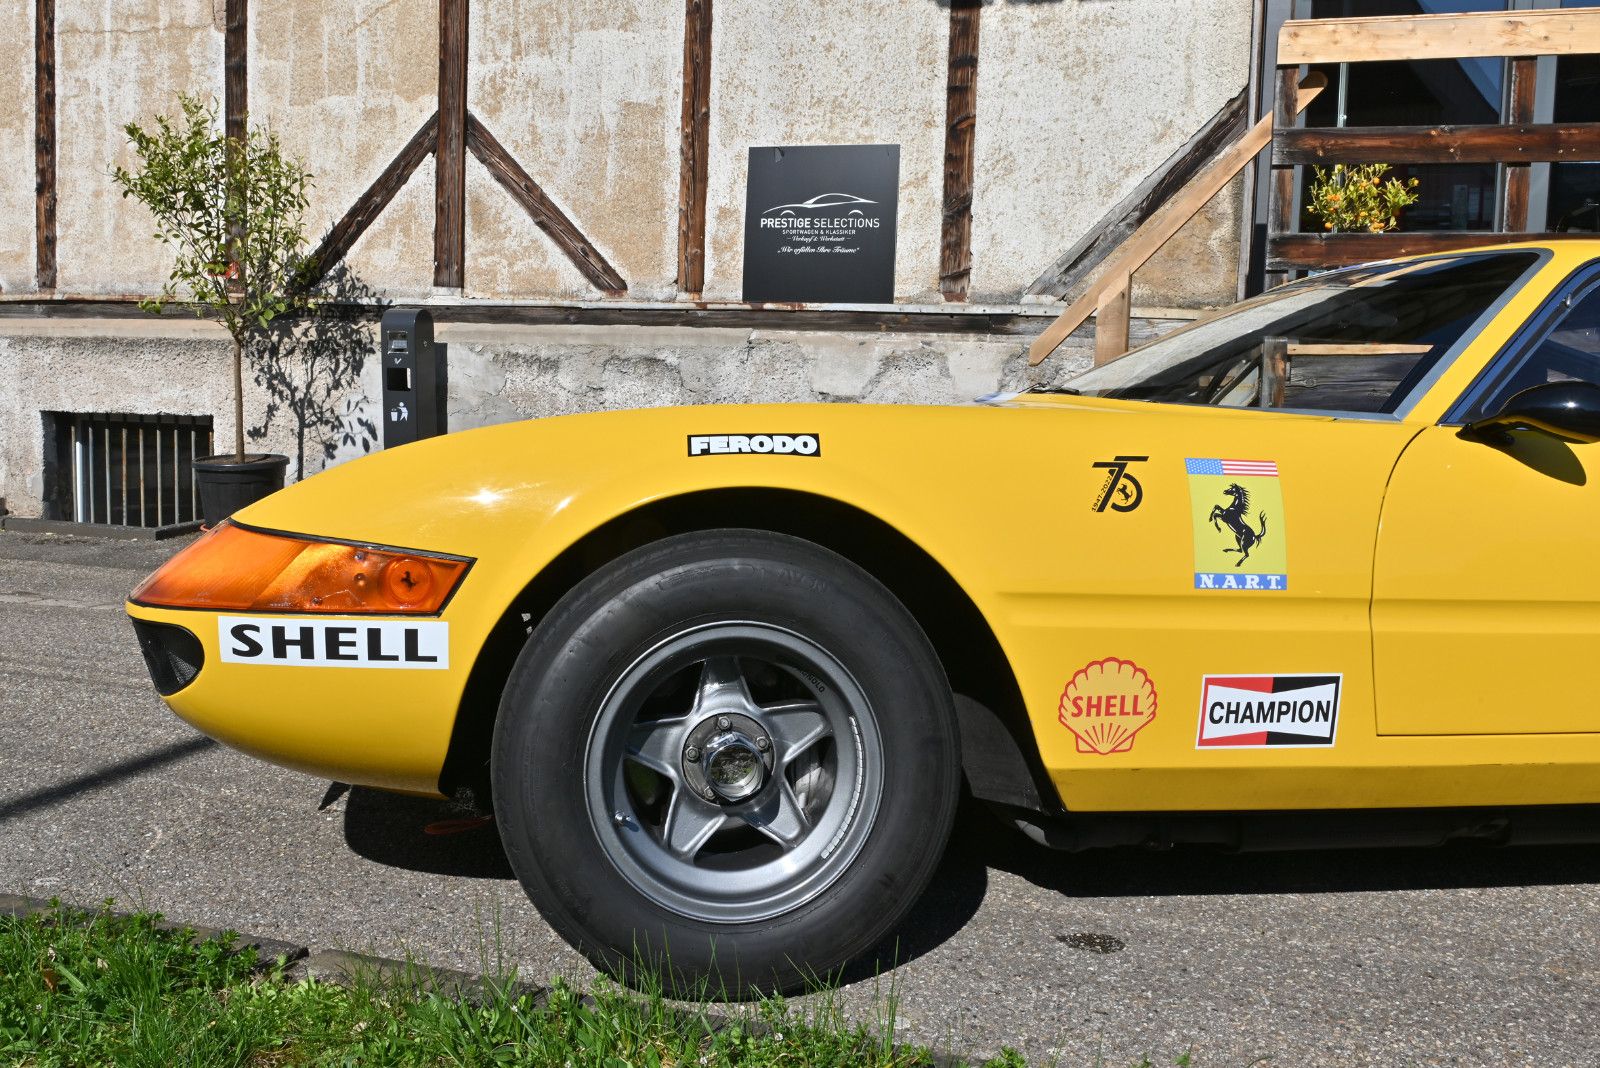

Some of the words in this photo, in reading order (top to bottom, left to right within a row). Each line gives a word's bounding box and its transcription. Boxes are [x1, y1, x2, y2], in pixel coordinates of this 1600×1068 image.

[760, 218, 811, 229] PRESTIGE
[814, 218, 880, 228] SELECTIONS
[690, 435, 818, 455] FERODO
[1092, 456, 1149, 512] 75
[230, 623, 438, 662] SHELL
[1071, 694, 1144, 718] SHELL
[1209, 699, 1331, 725] CHAMPION
